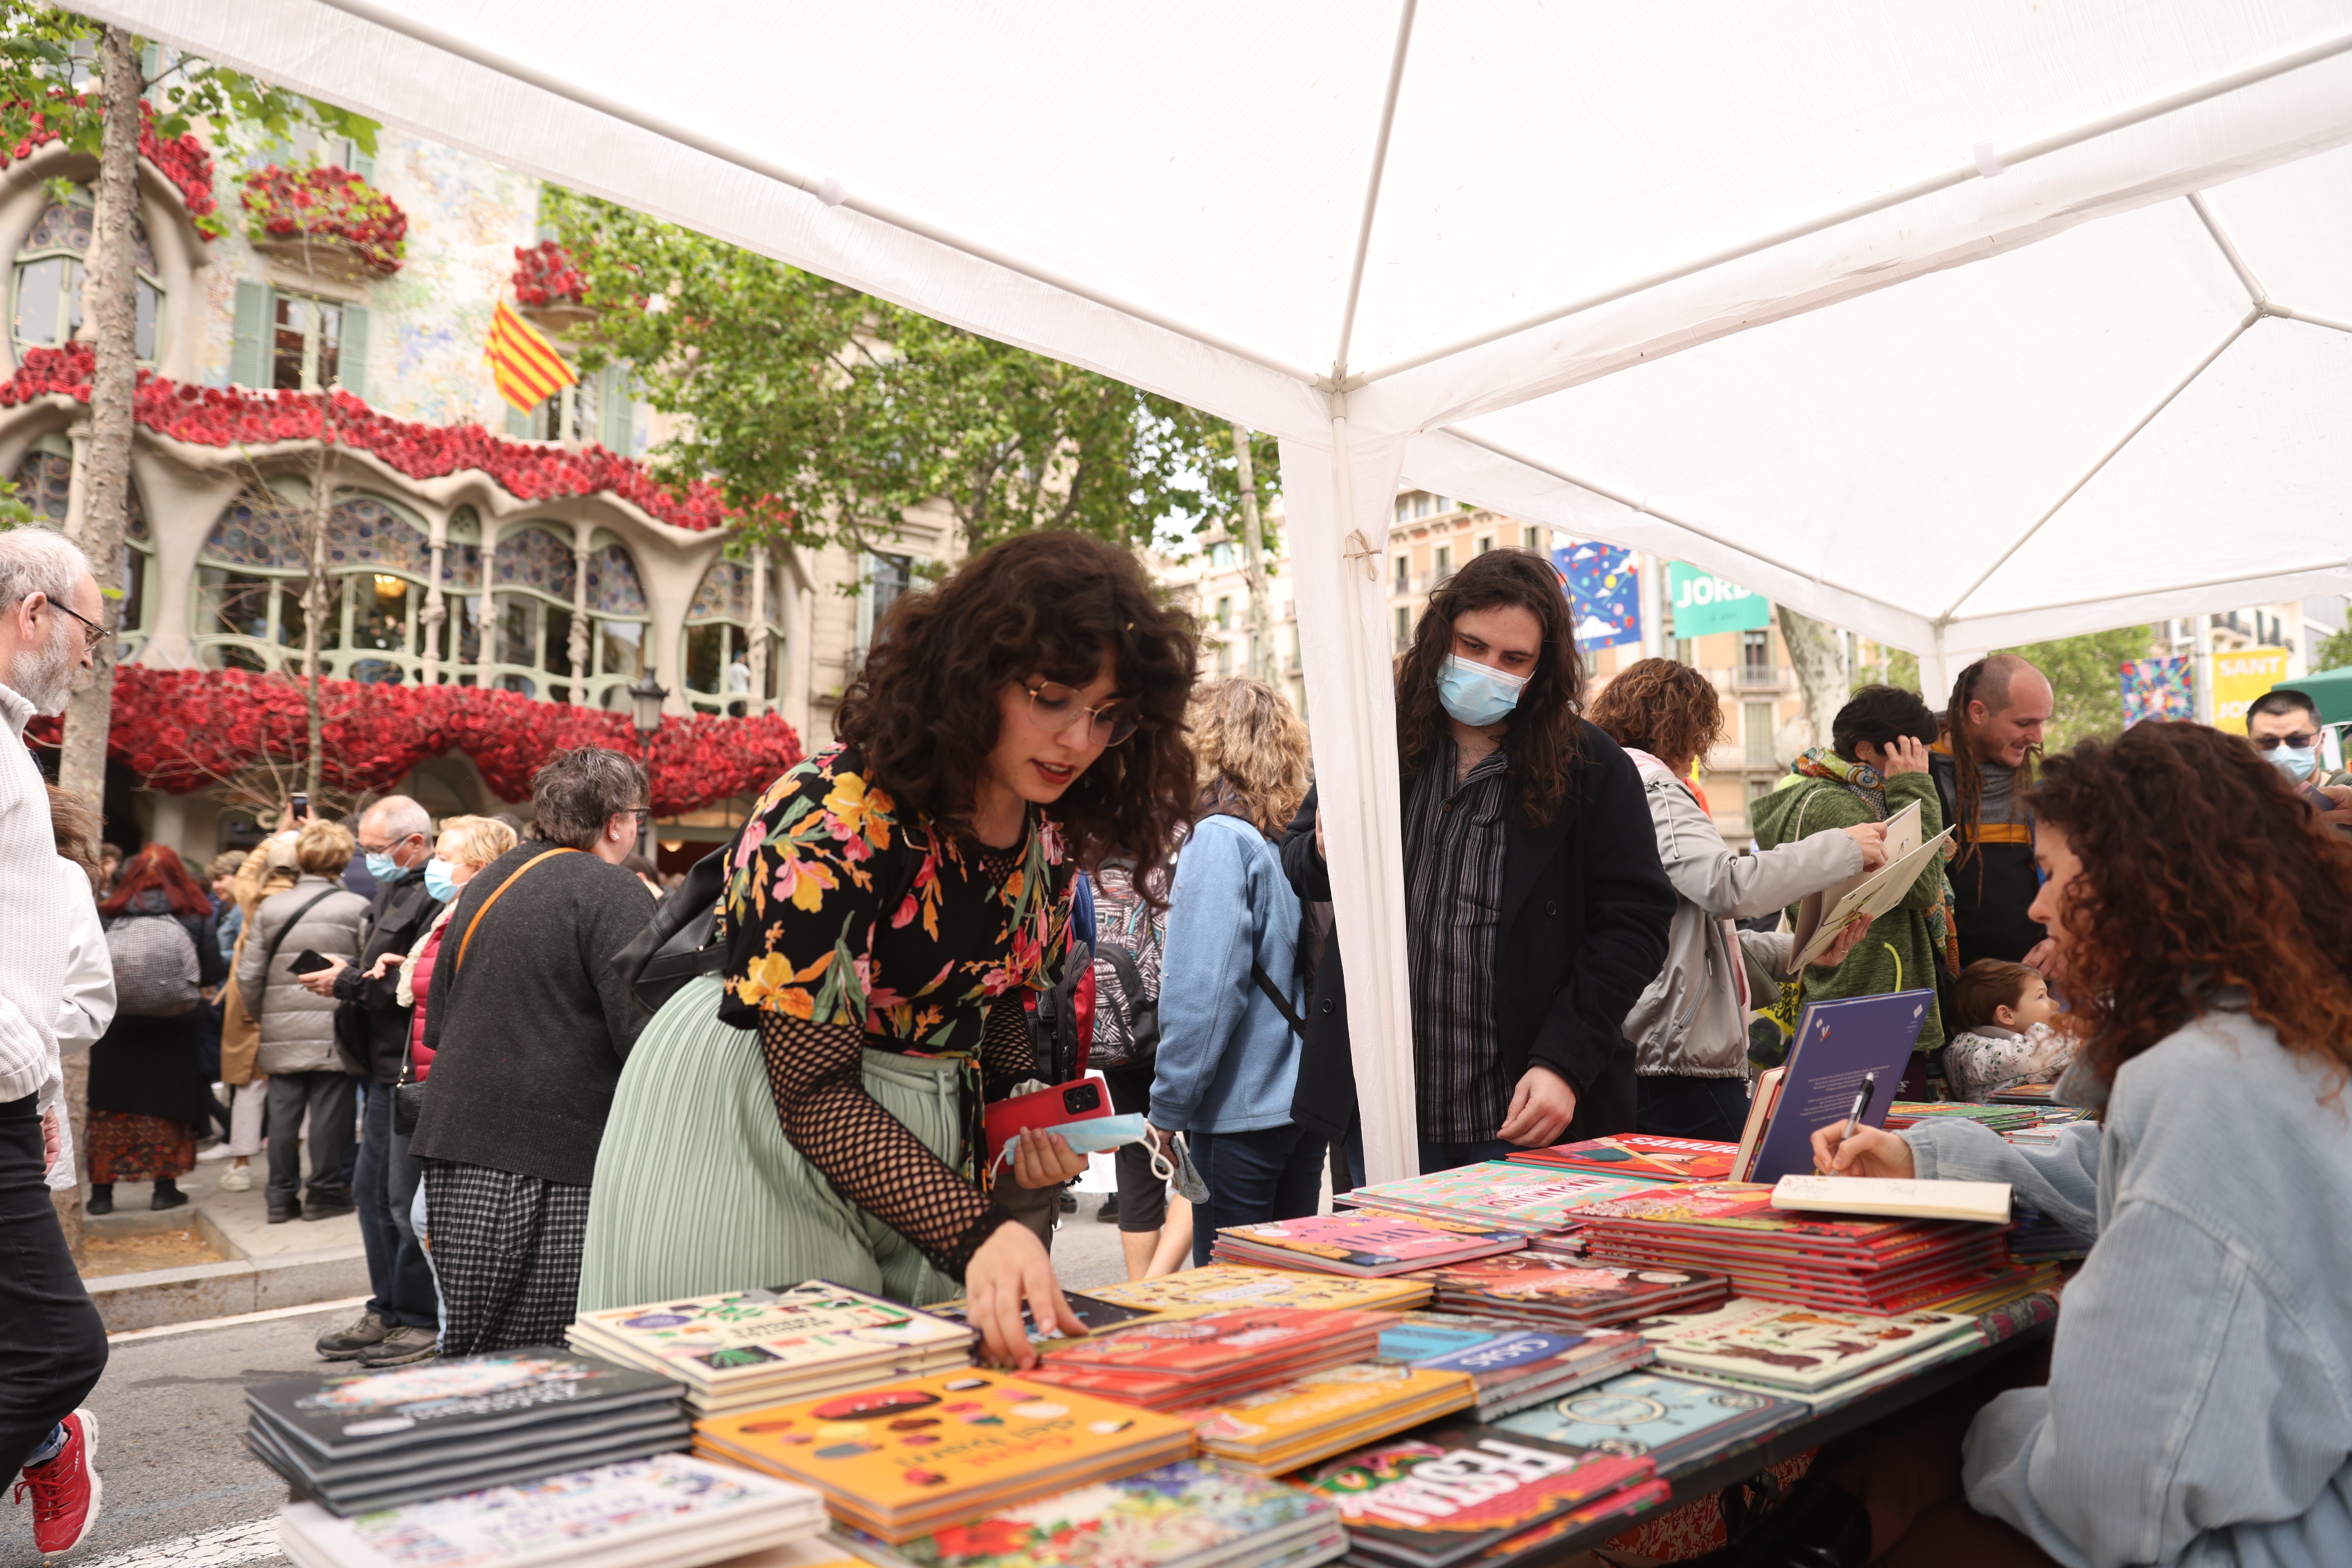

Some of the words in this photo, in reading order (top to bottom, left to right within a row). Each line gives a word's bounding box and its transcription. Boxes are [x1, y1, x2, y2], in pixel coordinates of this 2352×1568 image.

[2218, 656, 2282, 677] SANT
[1622, 1138, 1739, 1154] SAMUR
[1477, 1179, 1610, 1210] MAPAMUNDI
